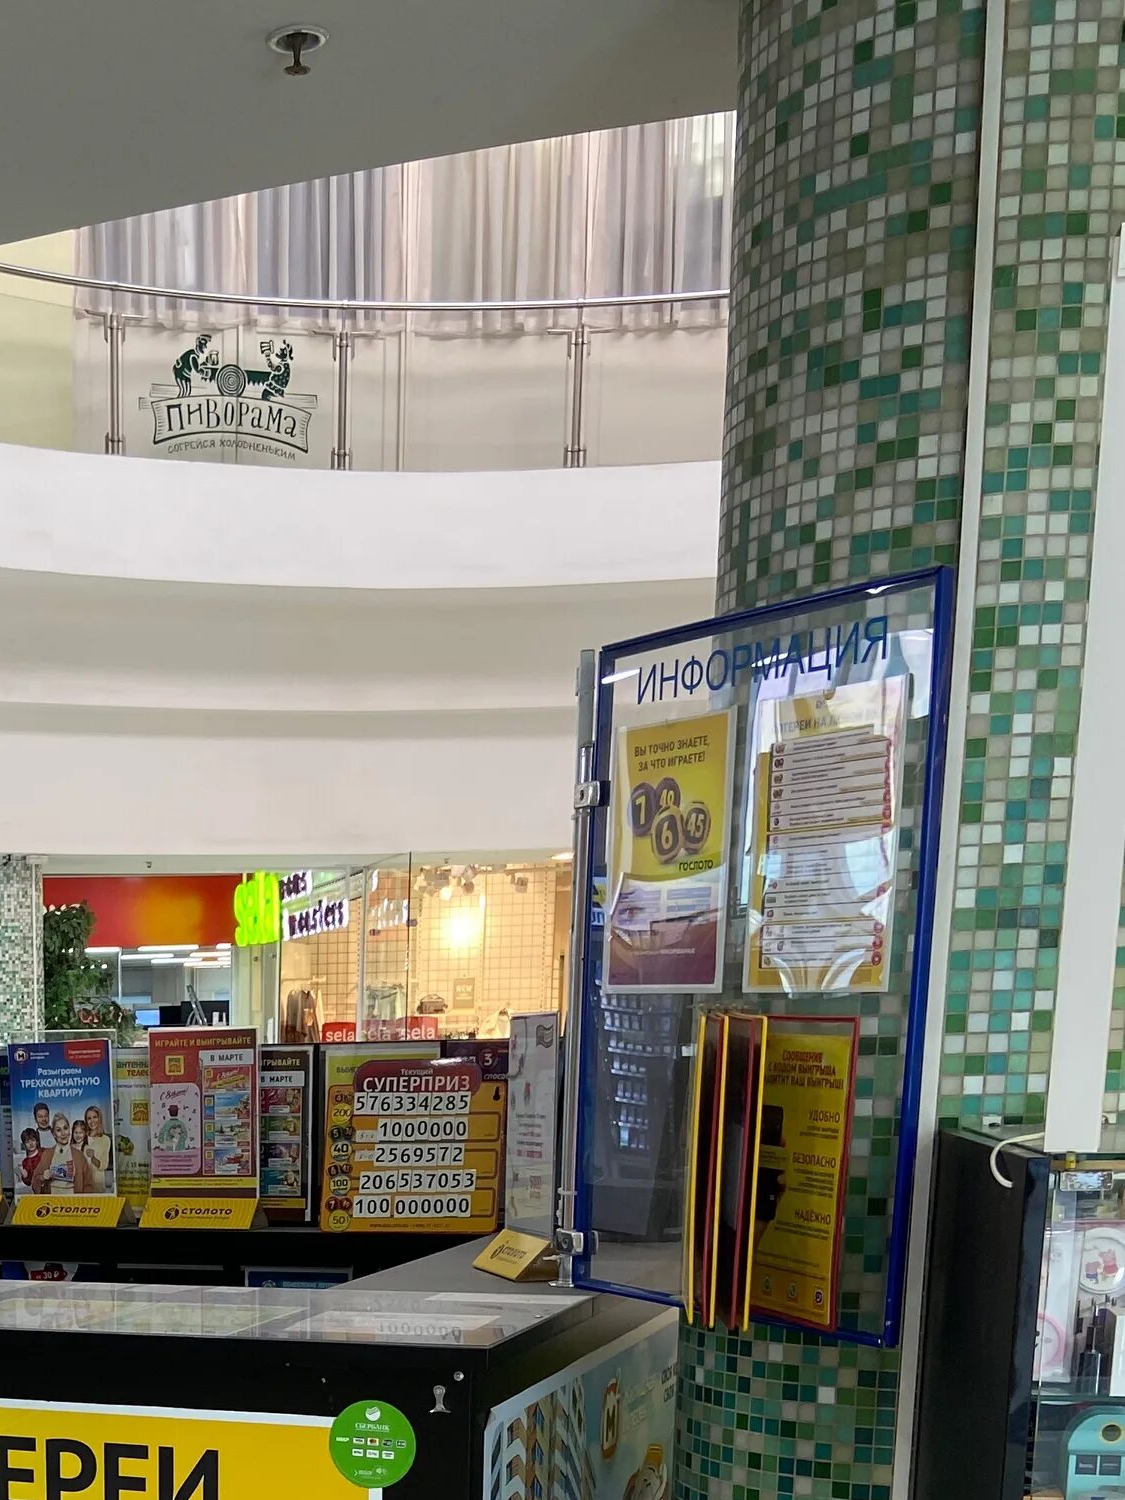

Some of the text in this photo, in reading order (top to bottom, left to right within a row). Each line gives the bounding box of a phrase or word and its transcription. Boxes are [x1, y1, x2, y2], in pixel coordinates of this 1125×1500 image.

[168, 439, 215, 453] СОГРЕЙСЯ
[637, 615, 887, 704] ИНФОРМАЦИЯ
[635, 735, 710, 757] ВЫ ТОЧНО ЗНАЕТЕ,
[639, 751, 705, 771] ЗА ЧТО ИГРАЕТЕ!
[662, 822, 672, 849] 6
[155, 1036, 251, 1048] ИГРАЙТЕ И ВЫИГРЫВАЙТЕ
[325, 1027, 354, 1042] sela
[20, 1077, 100, 1088] ТРЕХКОМНАТНУЮ
[363, 1076, 470, 1092] СУПЕРПРИЗ
[38, 1088, 83, 1098] КВАРТИРУ
[356, 1095, 468, 1111] 576334285
[809, 1109, 840, 1123] УДОБНО
[380, 1120, 466, 1137] 1000000
[334, 1144, 463, 1163] 40 2569572
[793, 1152, 836, 1168] БЕЗОПАСНО
[361, 1173, 474, 1190] 206537053
[52, 1206, 100, 1214] СТОЛОТО
[181, 1208, 232, 1216] СТОЛОТО
[355, 1199, 389, 1214] 100
